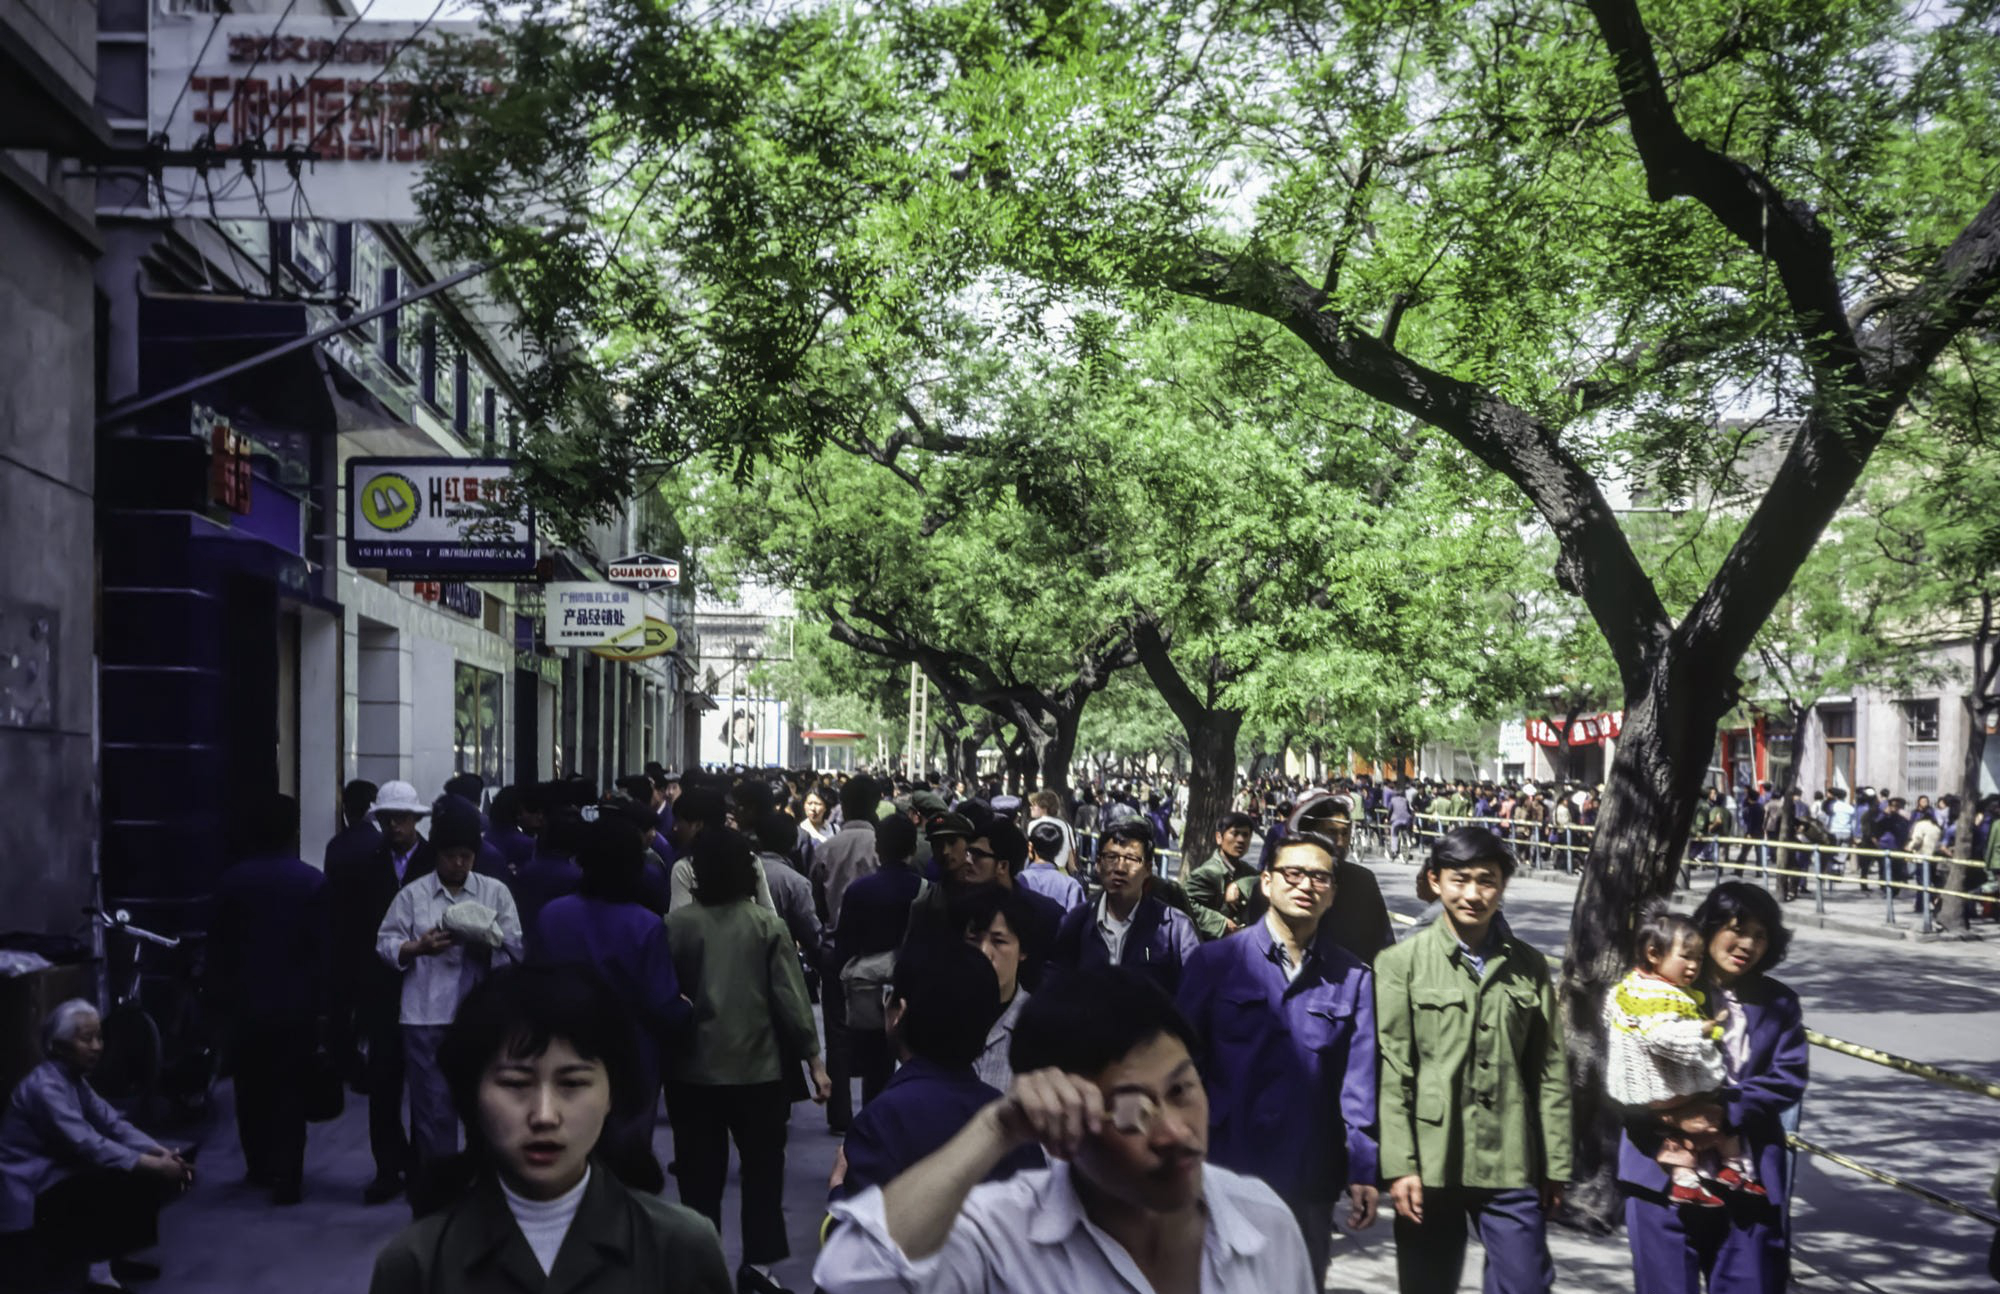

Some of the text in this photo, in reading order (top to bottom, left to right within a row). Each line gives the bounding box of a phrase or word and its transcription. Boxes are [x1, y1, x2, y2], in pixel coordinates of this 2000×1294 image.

[610, 567, 677, 578] GUANGYAO
[564, 608, 625, 626] 产品经销处
